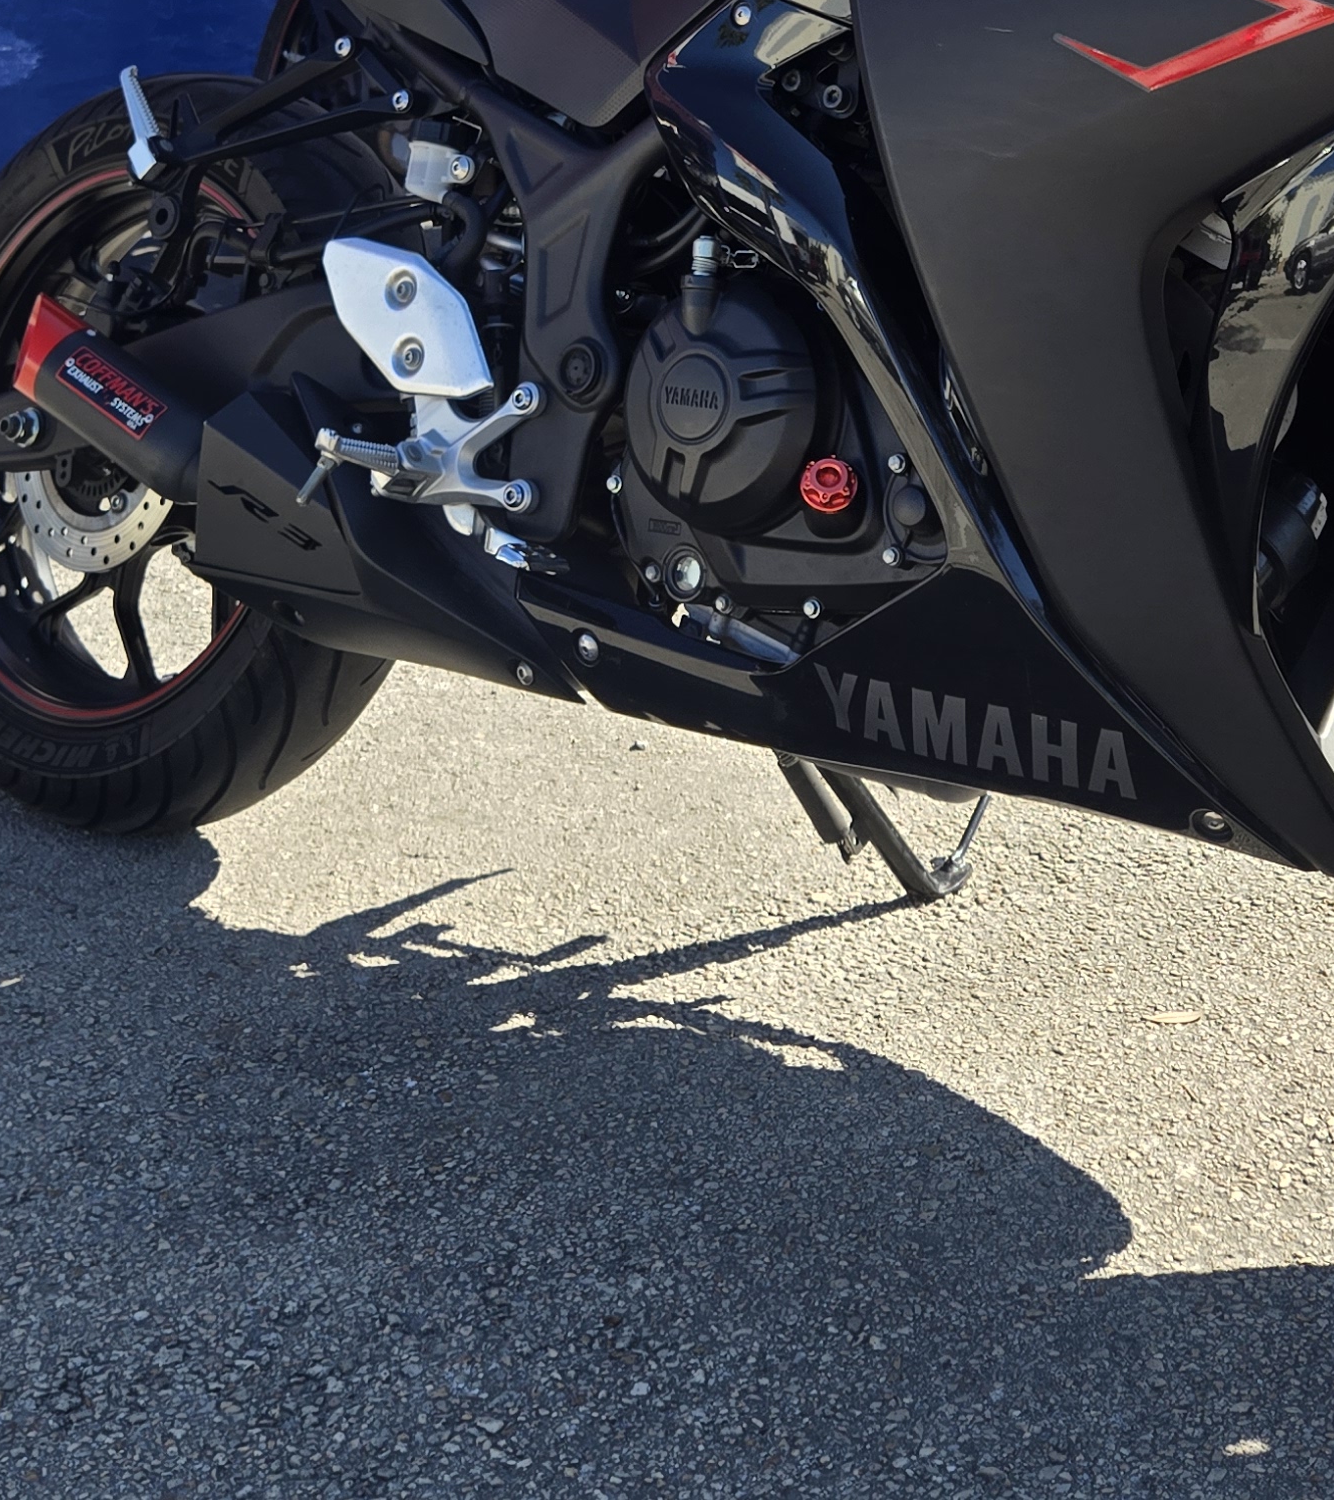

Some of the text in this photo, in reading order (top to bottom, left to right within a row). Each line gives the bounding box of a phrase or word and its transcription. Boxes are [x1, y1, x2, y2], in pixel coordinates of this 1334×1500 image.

[67, 365, 145, 427] EXHAUST SYSTEMS
[74, 352, 160, 416] COFFMAN'S
[665, 385, 719, 411] YAMAHA
[813, 661, 1138, 801] YAMAHA
